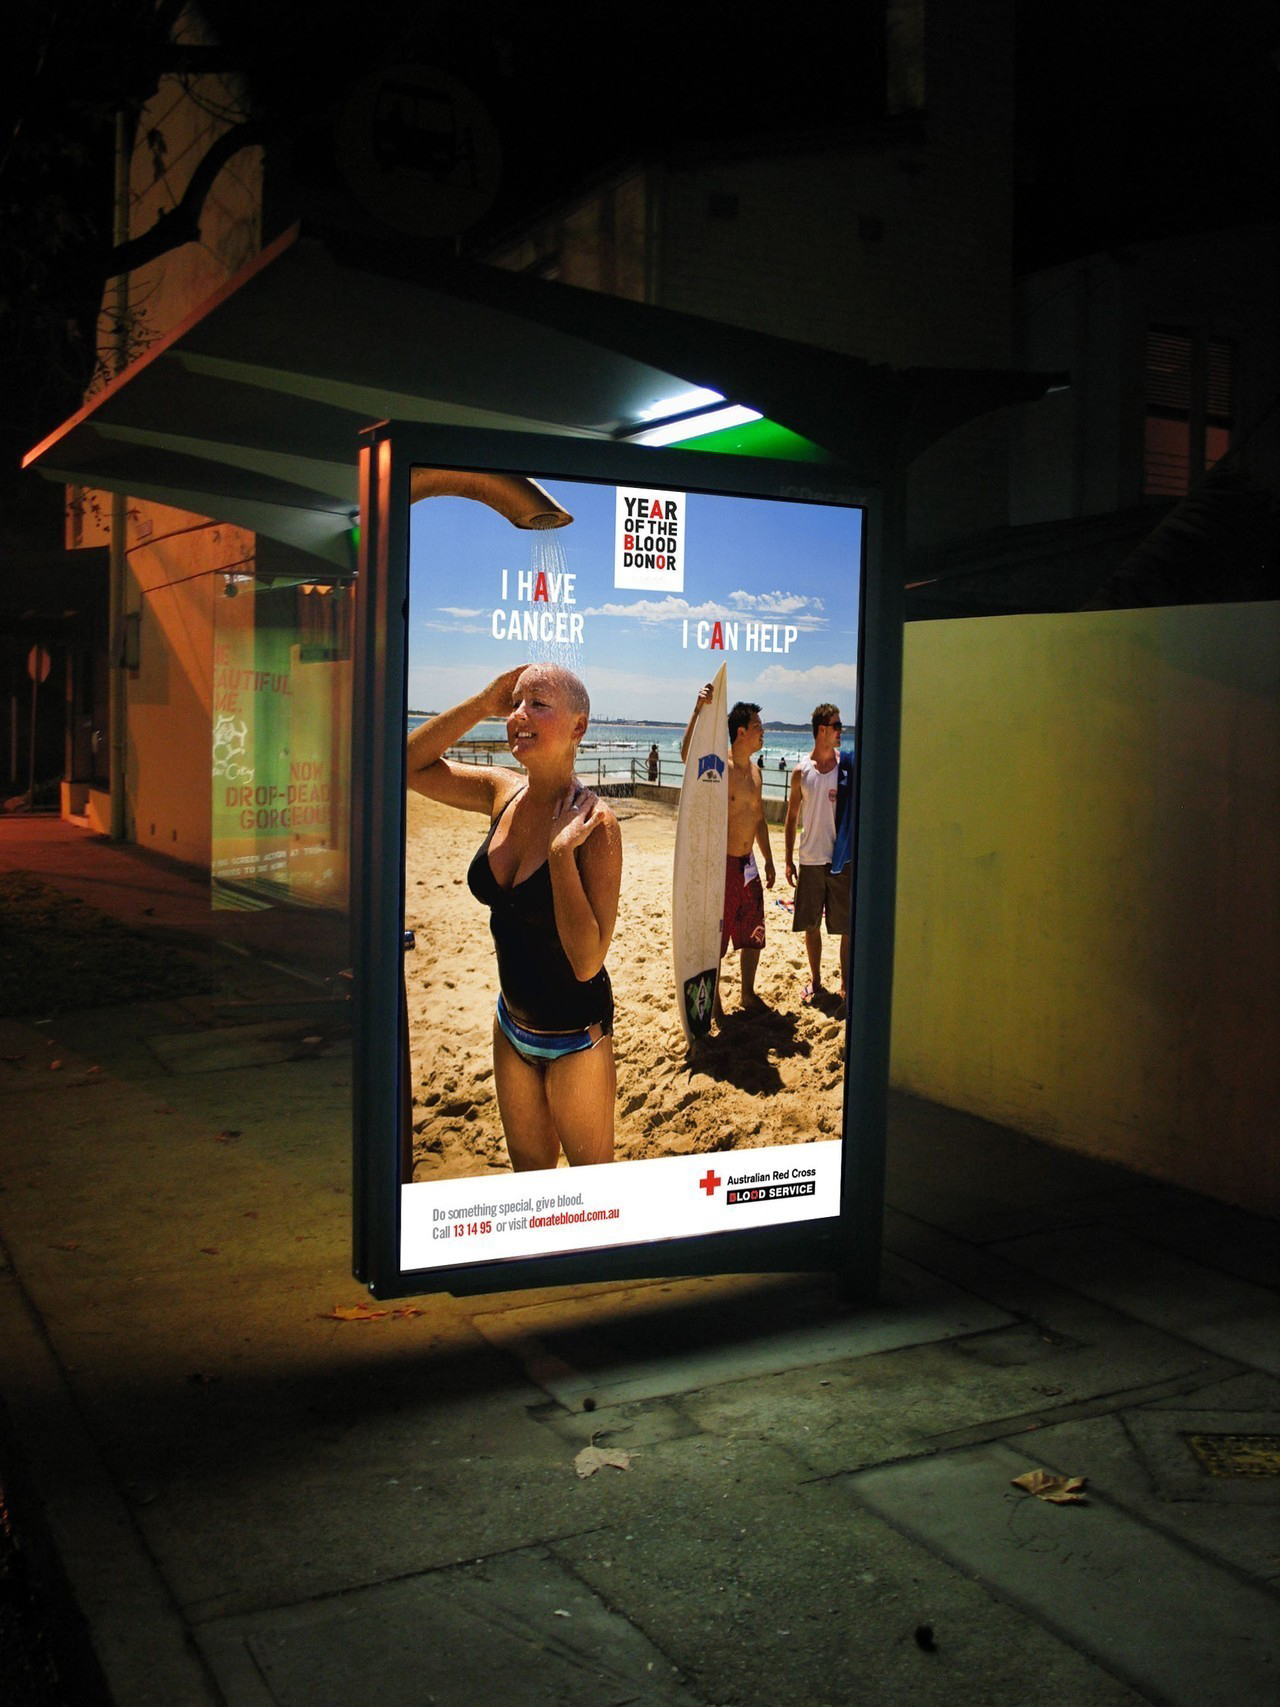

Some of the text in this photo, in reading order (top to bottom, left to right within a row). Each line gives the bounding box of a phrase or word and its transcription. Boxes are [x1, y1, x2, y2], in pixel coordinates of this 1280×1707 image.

[624, 497, 678, 521] YEAR
[624, 518, 678, 536] OF THE
[624, 534, 677, 553] BLOOD
[623, 552, 676, 571] DONOR
[502, 569, 577, 604] I HAVE
[492, 609, 585, 643] CANCER
[682, 619, 798, 653] I CAN HELP
[727, 1168, 816, 1186] Australian Red Cross
[728, 1184, 813, 1203] BLOOD SERVICE
[432, 1192, 584, 1222] Do something special, give blood.
[432, 1208, 620, 1240] Call 13 14 95 or visit donateblood.com.au
